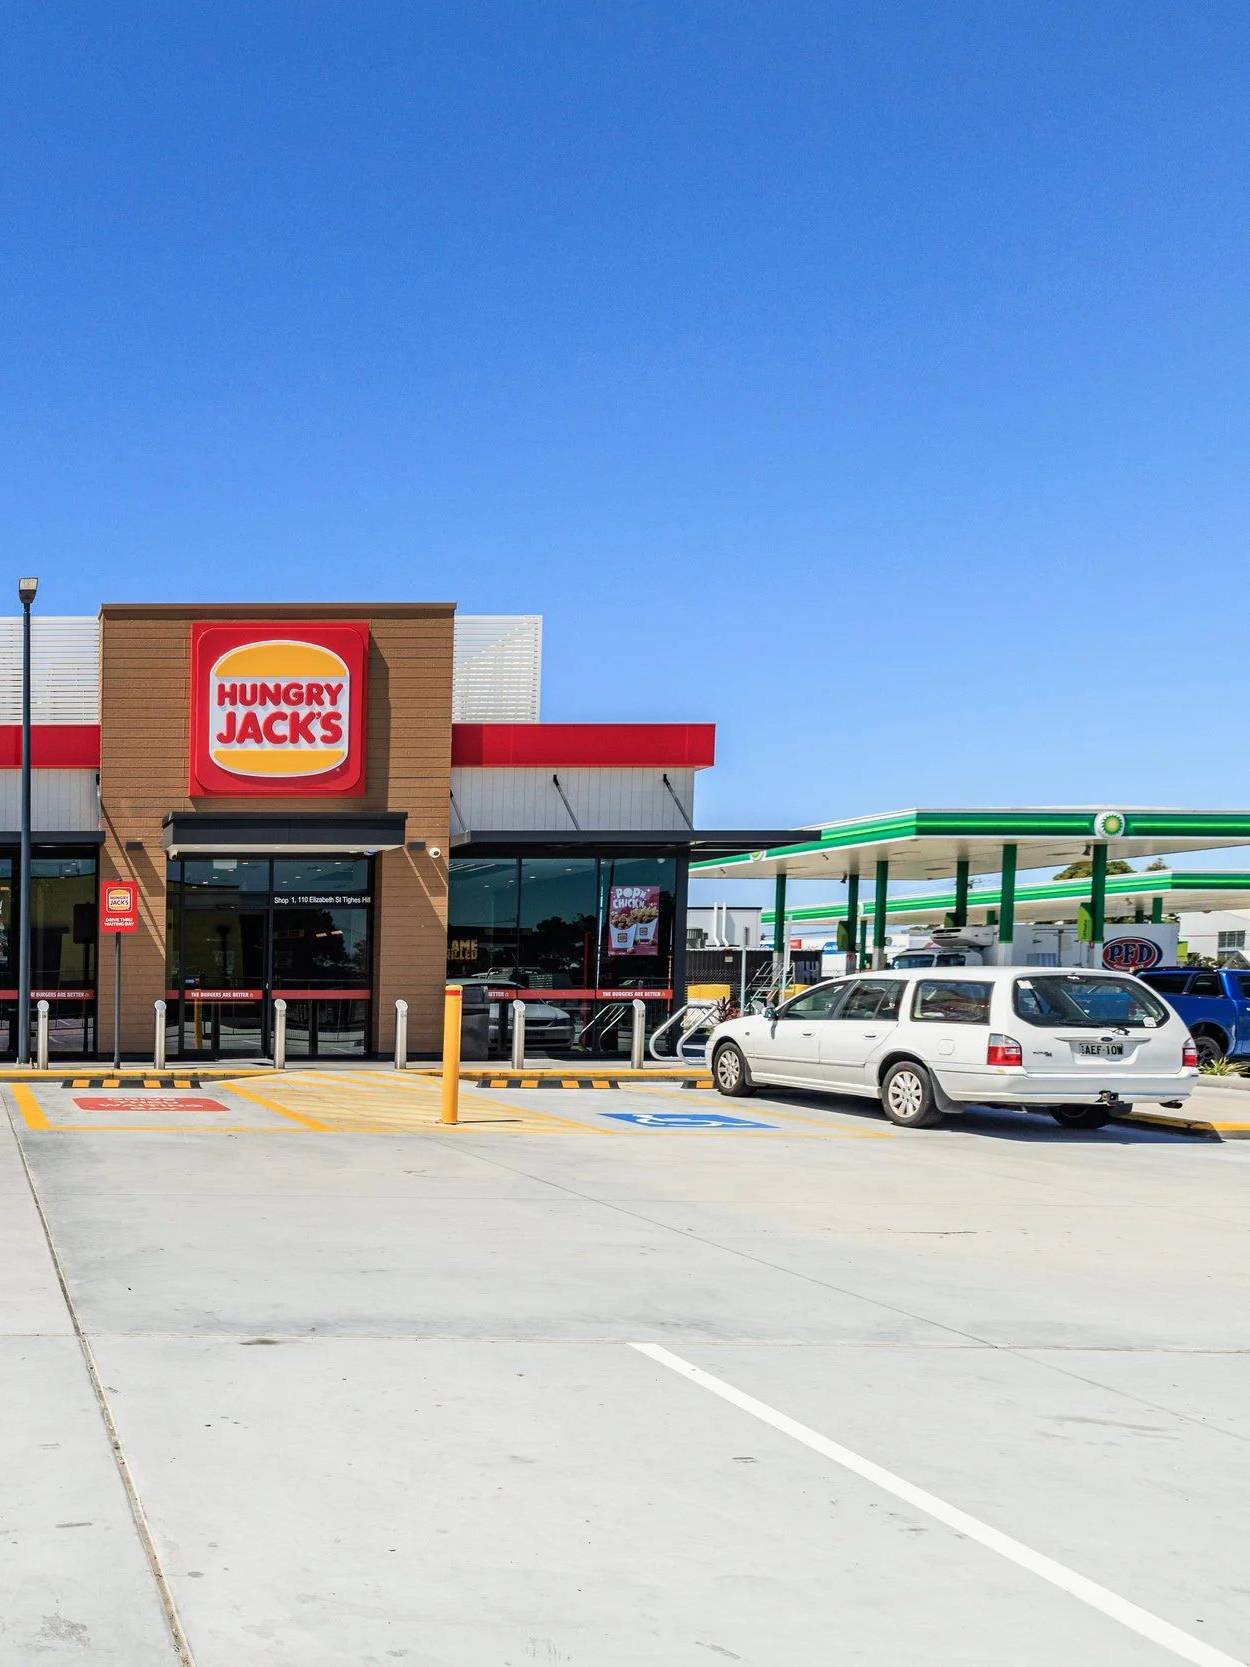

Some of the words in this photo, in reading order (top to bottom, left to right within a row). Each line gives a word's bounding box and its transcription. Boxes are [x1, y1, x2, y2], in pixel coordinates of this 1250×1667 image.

[216, 682, 344, 707] HUNGRY
[216, 710, 343, 745] JACK'S
[274, 896, 289, 905] Shop
[342, 896, 361, 905] Tighes
[451, 939, 478, 951] AME
[1107, 942, 1154, 965] PFD
[447, 949, 478, 960] RILLED
